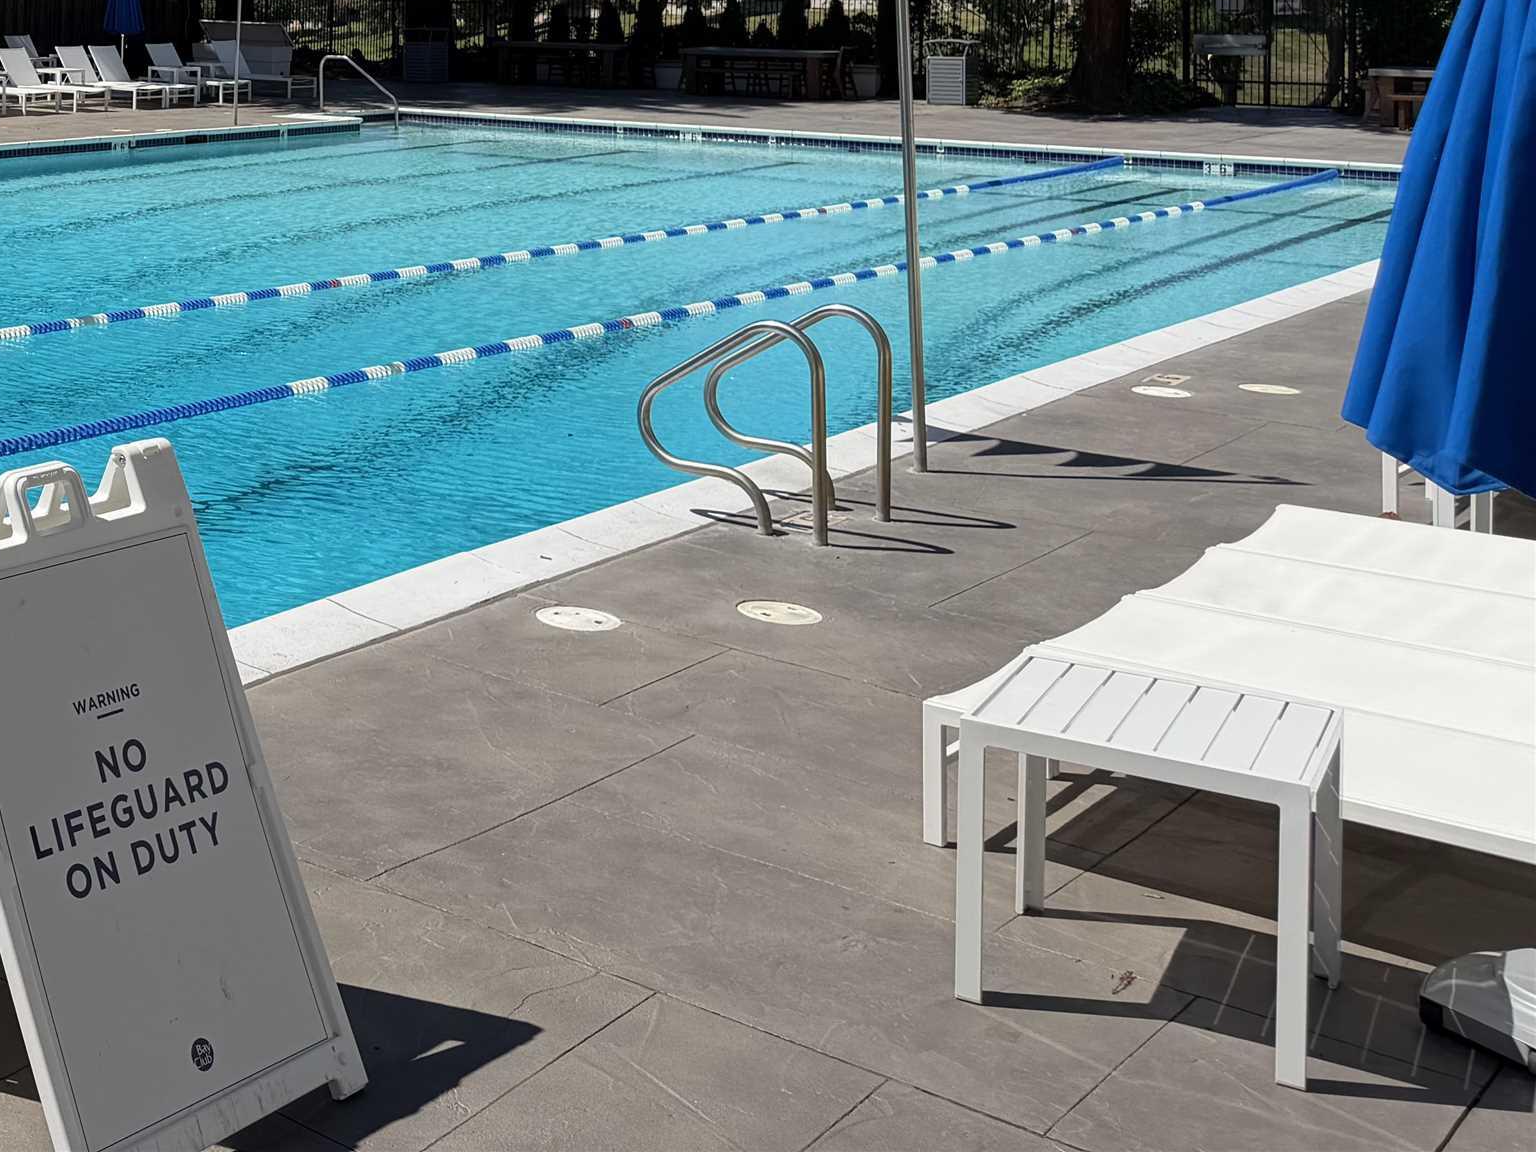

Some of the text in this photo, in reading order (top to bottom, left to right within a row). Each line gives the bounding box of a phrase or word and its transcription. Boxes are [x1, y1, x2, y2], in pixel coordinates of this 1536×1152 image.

[72, 682, 141, 715] WARNING
[94, 738, 147, 784] NO
[28, 760, 230, 860] LIFEGUARD
[65, 811, 219, 900] ON DUTY
[195, 1054, 213, 1069] Club
[196, 1043, 211, 1055] Bay
